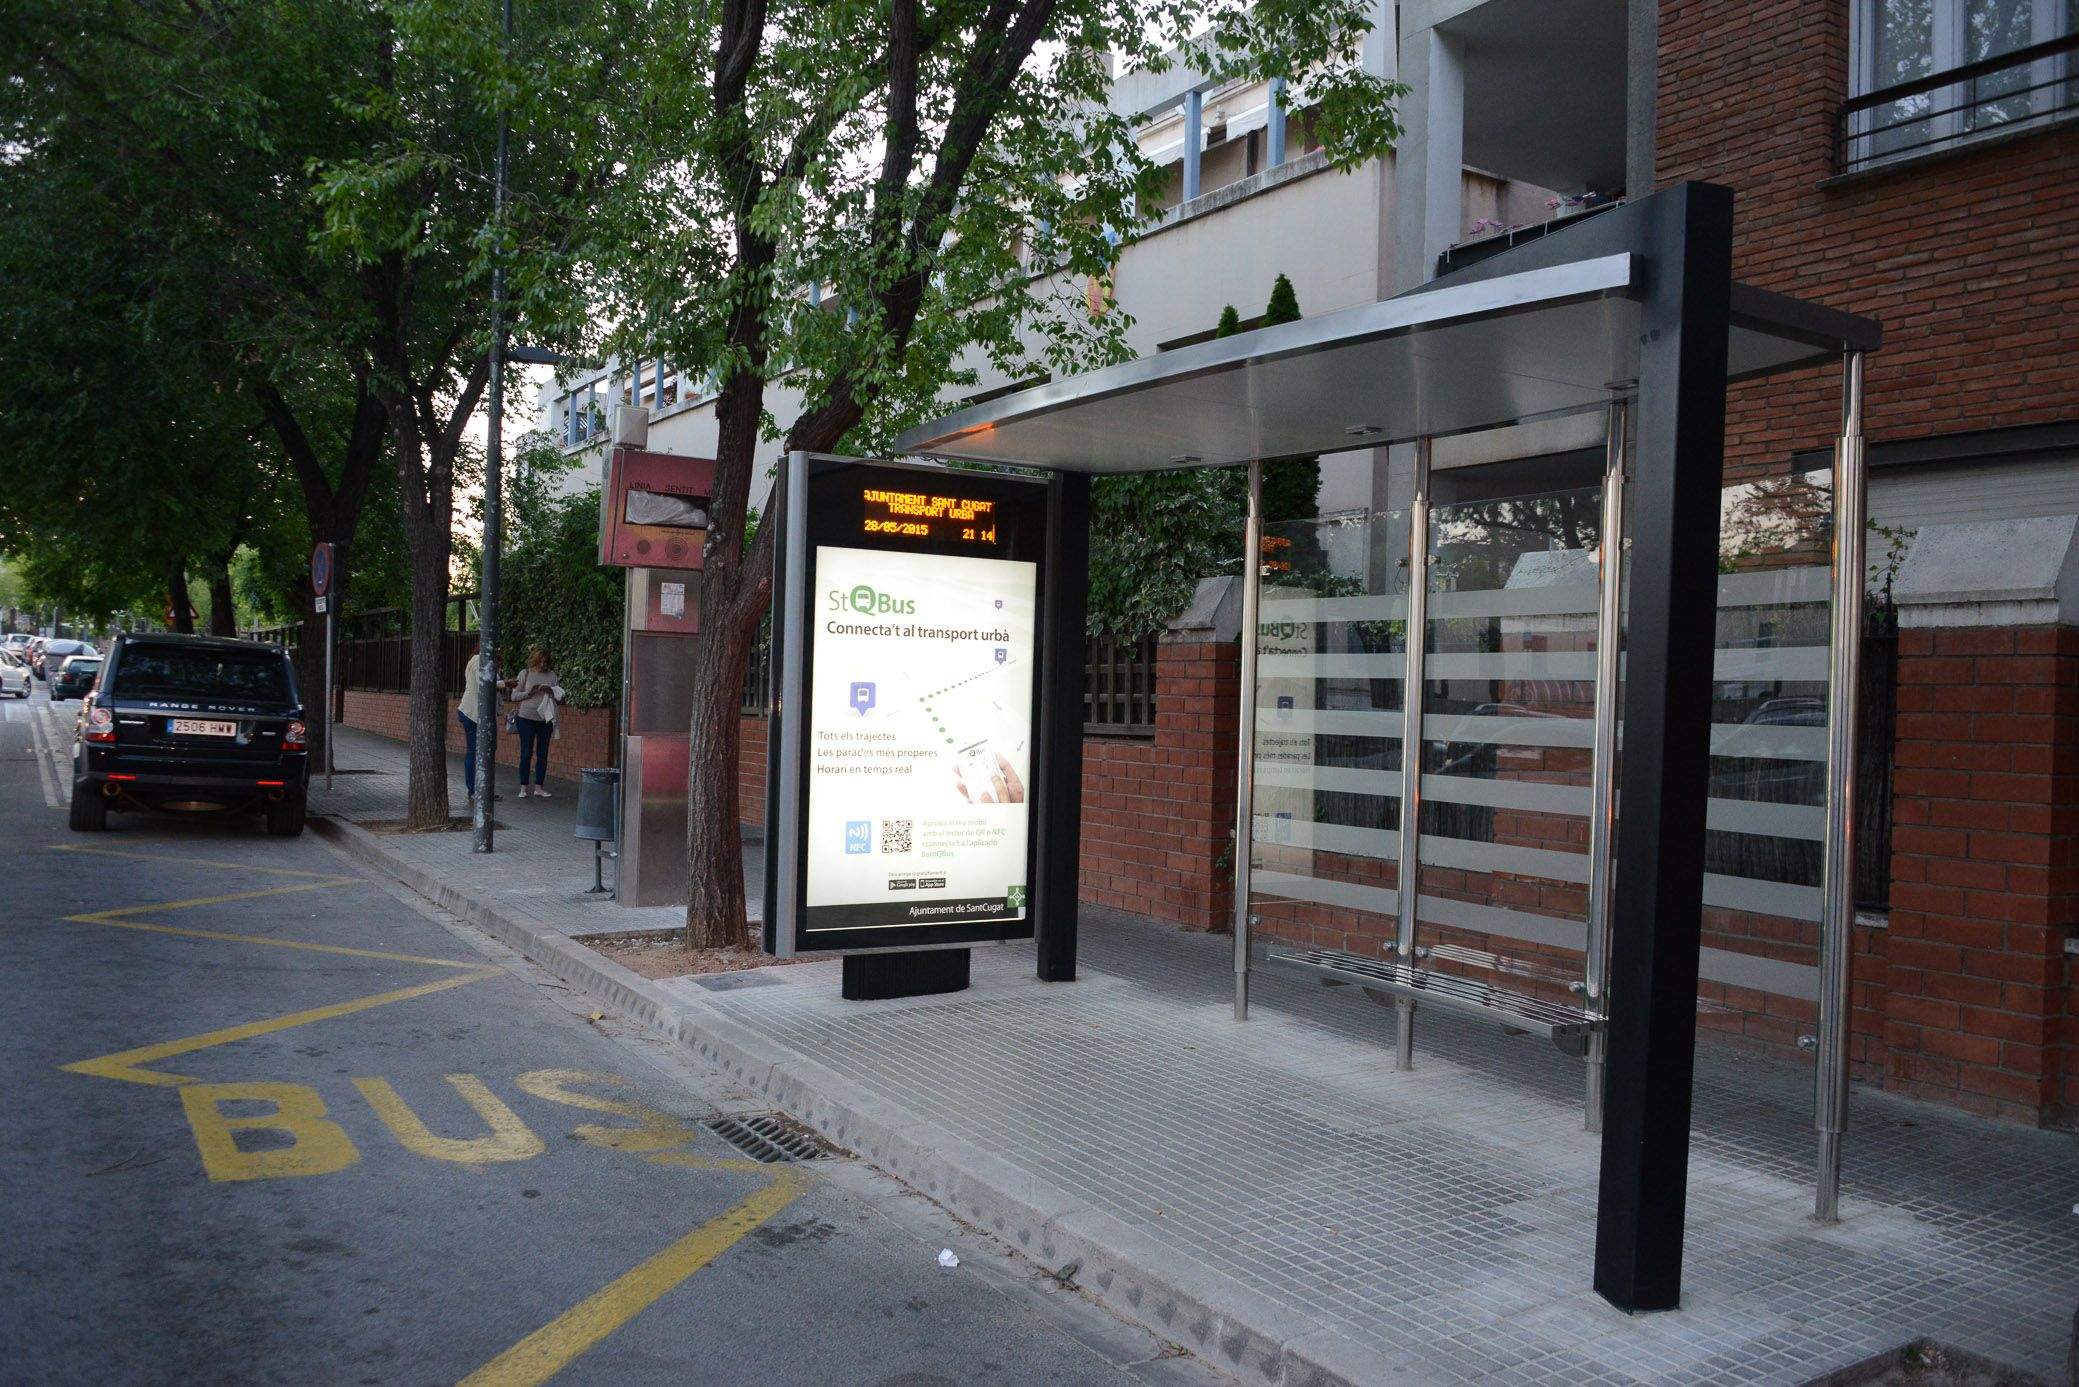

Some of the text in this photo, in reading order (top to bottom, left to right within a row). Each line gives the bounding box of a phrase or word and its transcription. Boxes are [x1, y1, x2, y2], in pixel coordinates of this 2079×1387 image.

[664, 484, 693, 494] SENTIT
[864, 490, 992, 512] AJUNTAMENT SANT CUGAT
[888, 503, 944, 517] TRANSPORT
[864, 520, 929, 535] 28/05/2015
[828, 585, 916, 616] StQBus
[827, 621, 1010, 642] Connecta't al transport urbà
[176, 721, 206, 732] 2506
[819, 731, 897, 742] Tots els trajectes
[817, 747, 834, 757] Les
[897, 750, 938, 759] properes
[817, 764, 912, 775] Horari en temps real
[909, 906, 954, 917] Ajuntament
[955, 904, 966, 913] de
[178, 1067, 695, 1184] BUS
